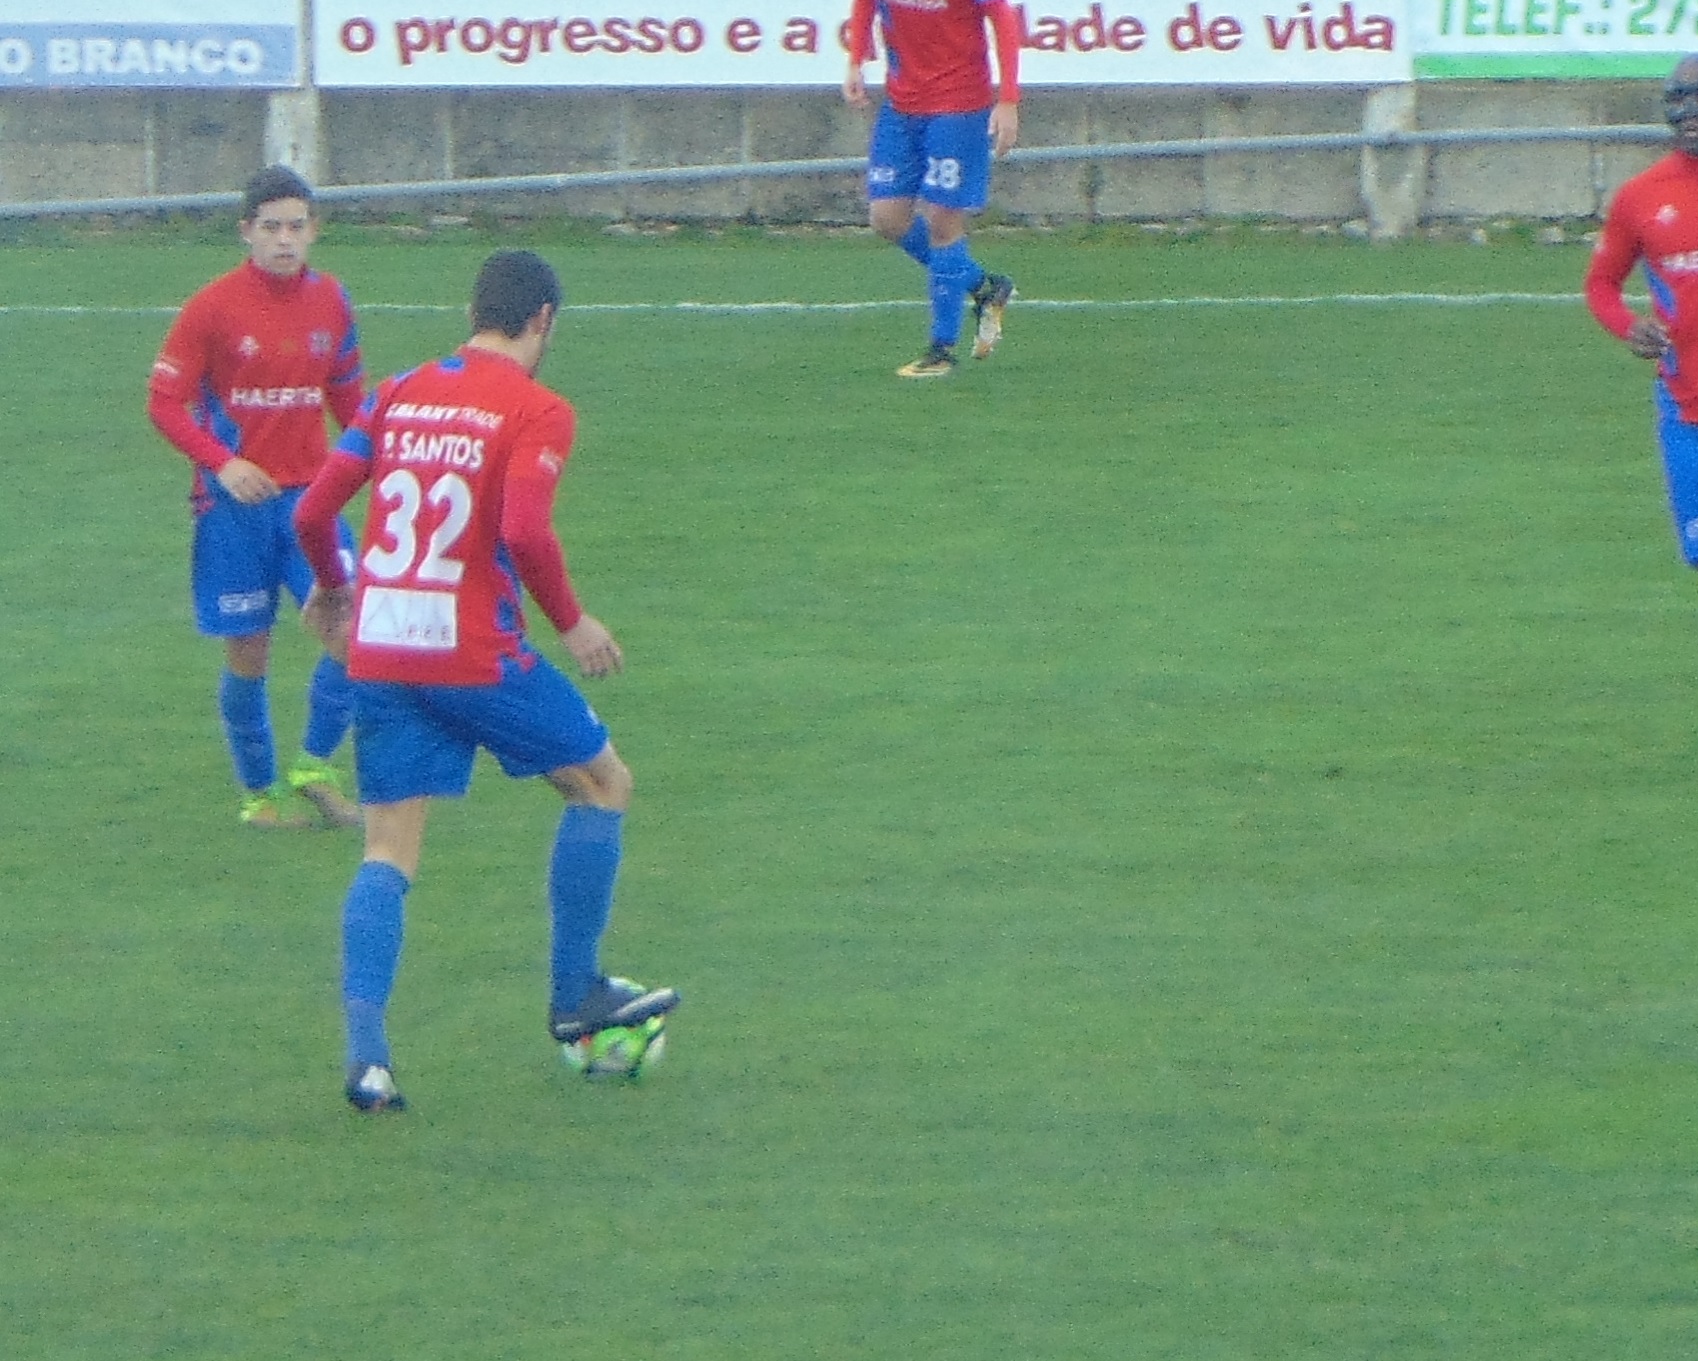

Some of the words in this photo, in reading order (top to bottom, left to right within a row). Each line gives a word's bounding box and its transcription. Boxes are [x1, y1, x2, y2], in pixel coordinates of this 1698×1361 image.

[339, 16, 377, 54] o
[394, 15, 706, 65] progresso
[725, 16, 762, 53] e
[781, 16, 820, 54] a
[1168, 1, 1242, 53] de
[1264, 1, 1396, 53] vida
[47, 37, 265, 76] BRANCO
[230, 386, 323, 411] HAERTH
[399, 430, 485, 471] SANTOS
[363, 468, 473, 584] 32
